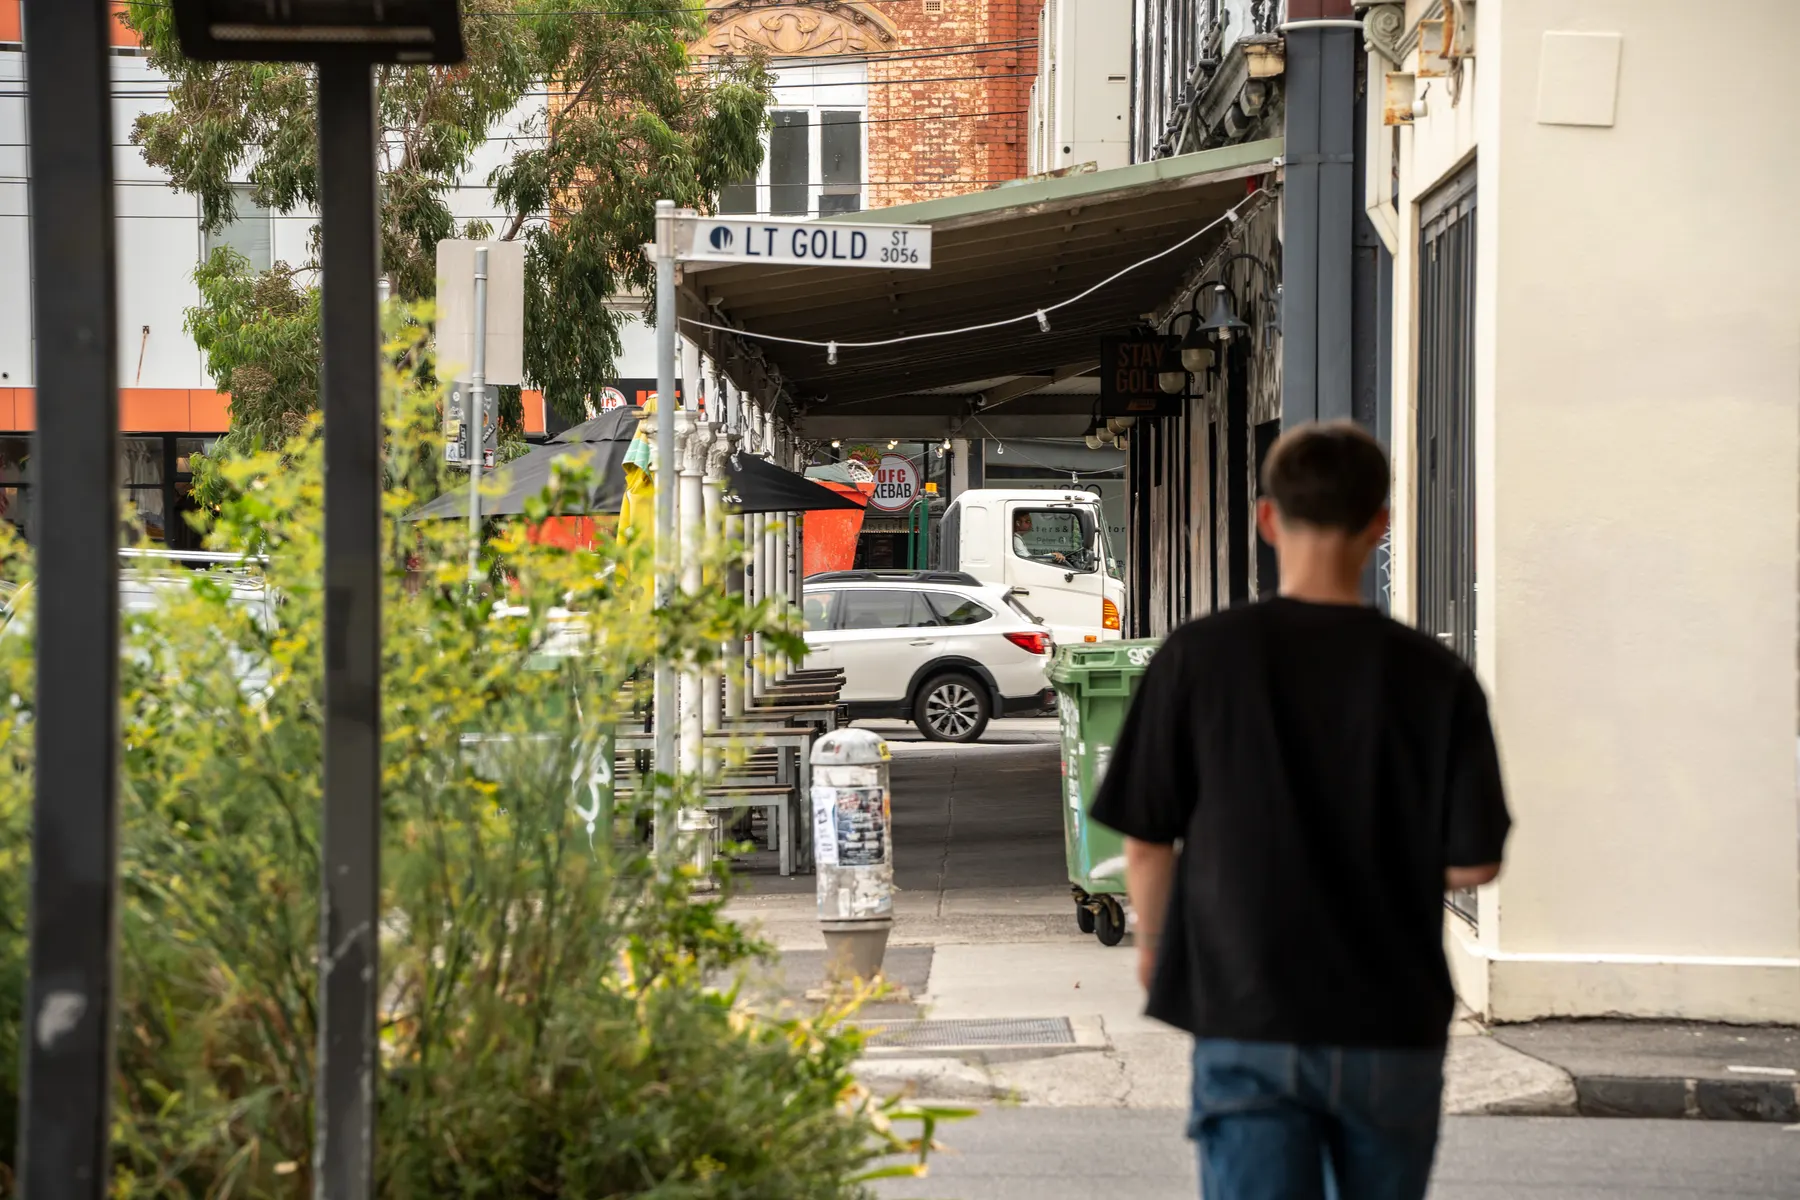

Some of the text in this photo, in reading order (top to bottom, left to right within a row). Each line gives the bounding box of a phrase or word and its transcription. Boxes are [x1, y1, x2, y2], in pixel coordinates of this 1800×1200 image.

[746, 226, 867, 259] LT GOLD
[891, 230, 908, 246] ST
[880, 247, 919, 263] 3056
[1118, 343, 1165, 368] STAY
[877, 469, 906, 483] UFC
[873, 483, 912, 499] KEBAB
